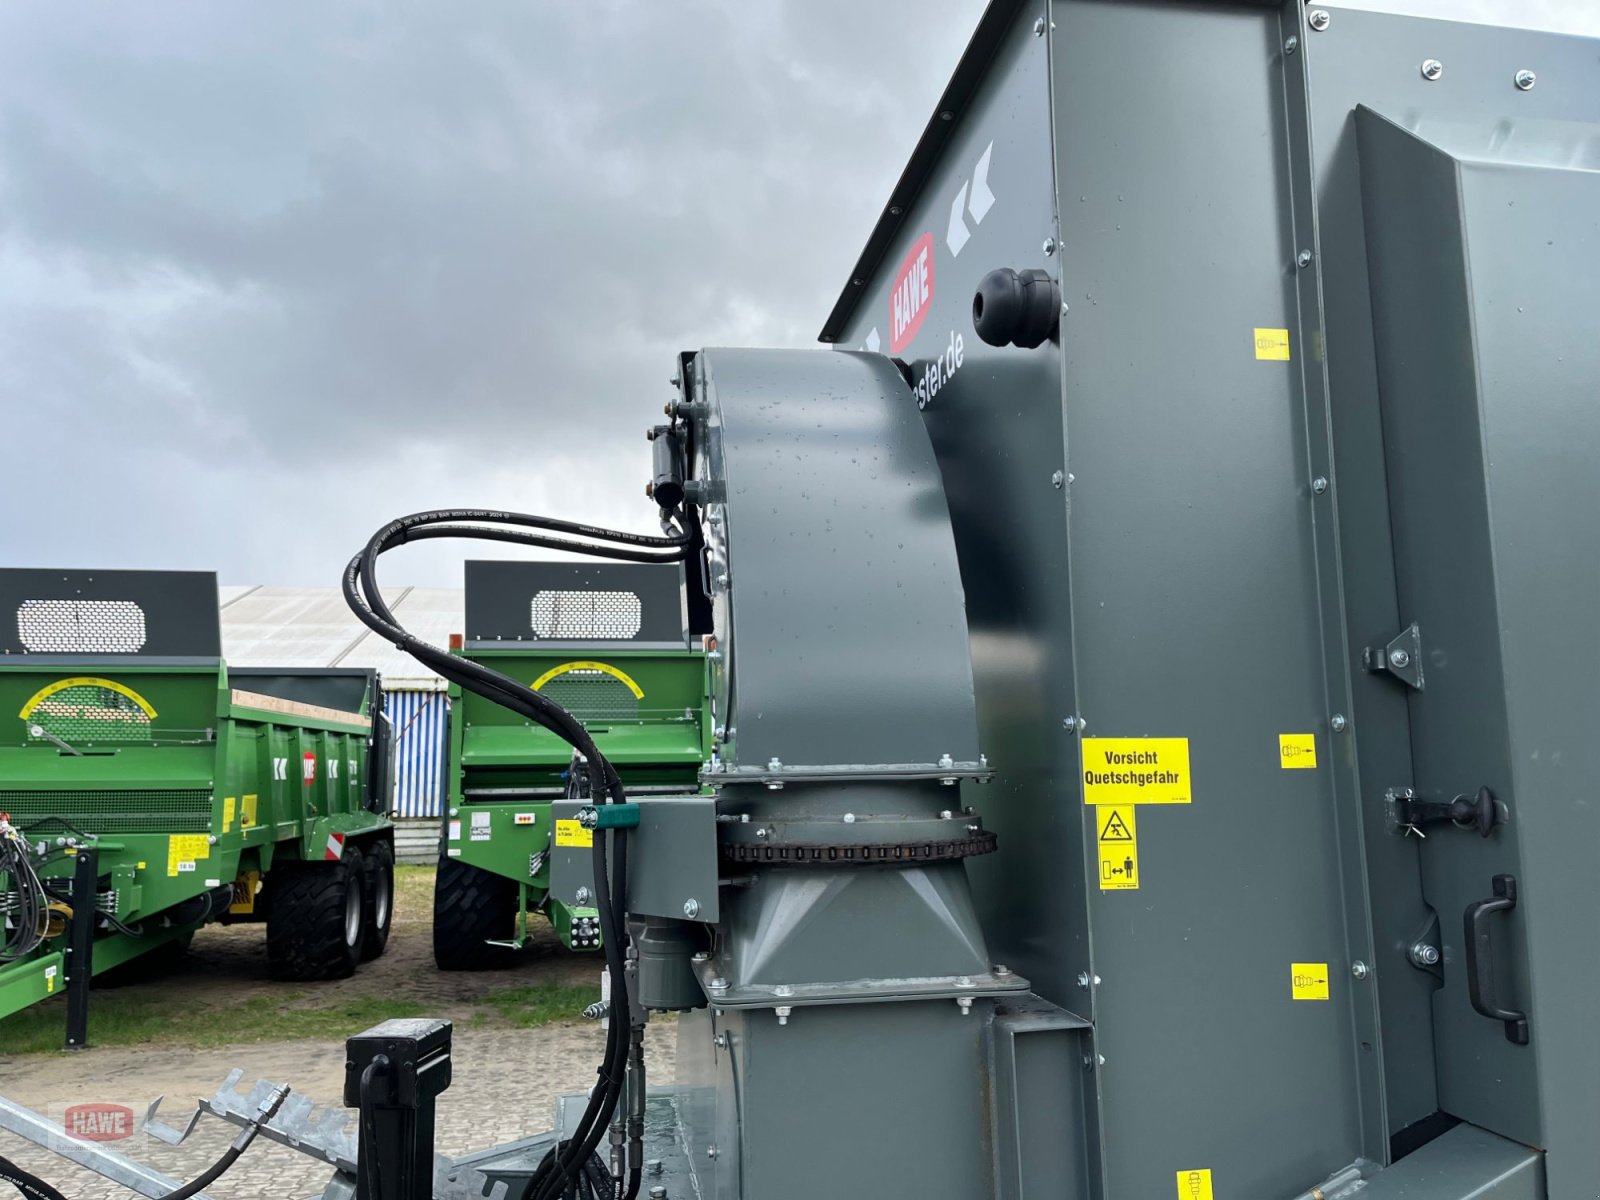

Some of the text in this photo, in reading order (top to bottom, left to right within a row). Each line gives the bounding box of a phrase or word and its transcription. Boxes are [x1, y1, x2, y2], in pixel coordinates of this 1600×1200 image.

[893, 246, 929, 341] HAWE
[1105, 751, 1158, 764] Vorsicht
[1085, 771, 1179, 787] Quetschgefahr
